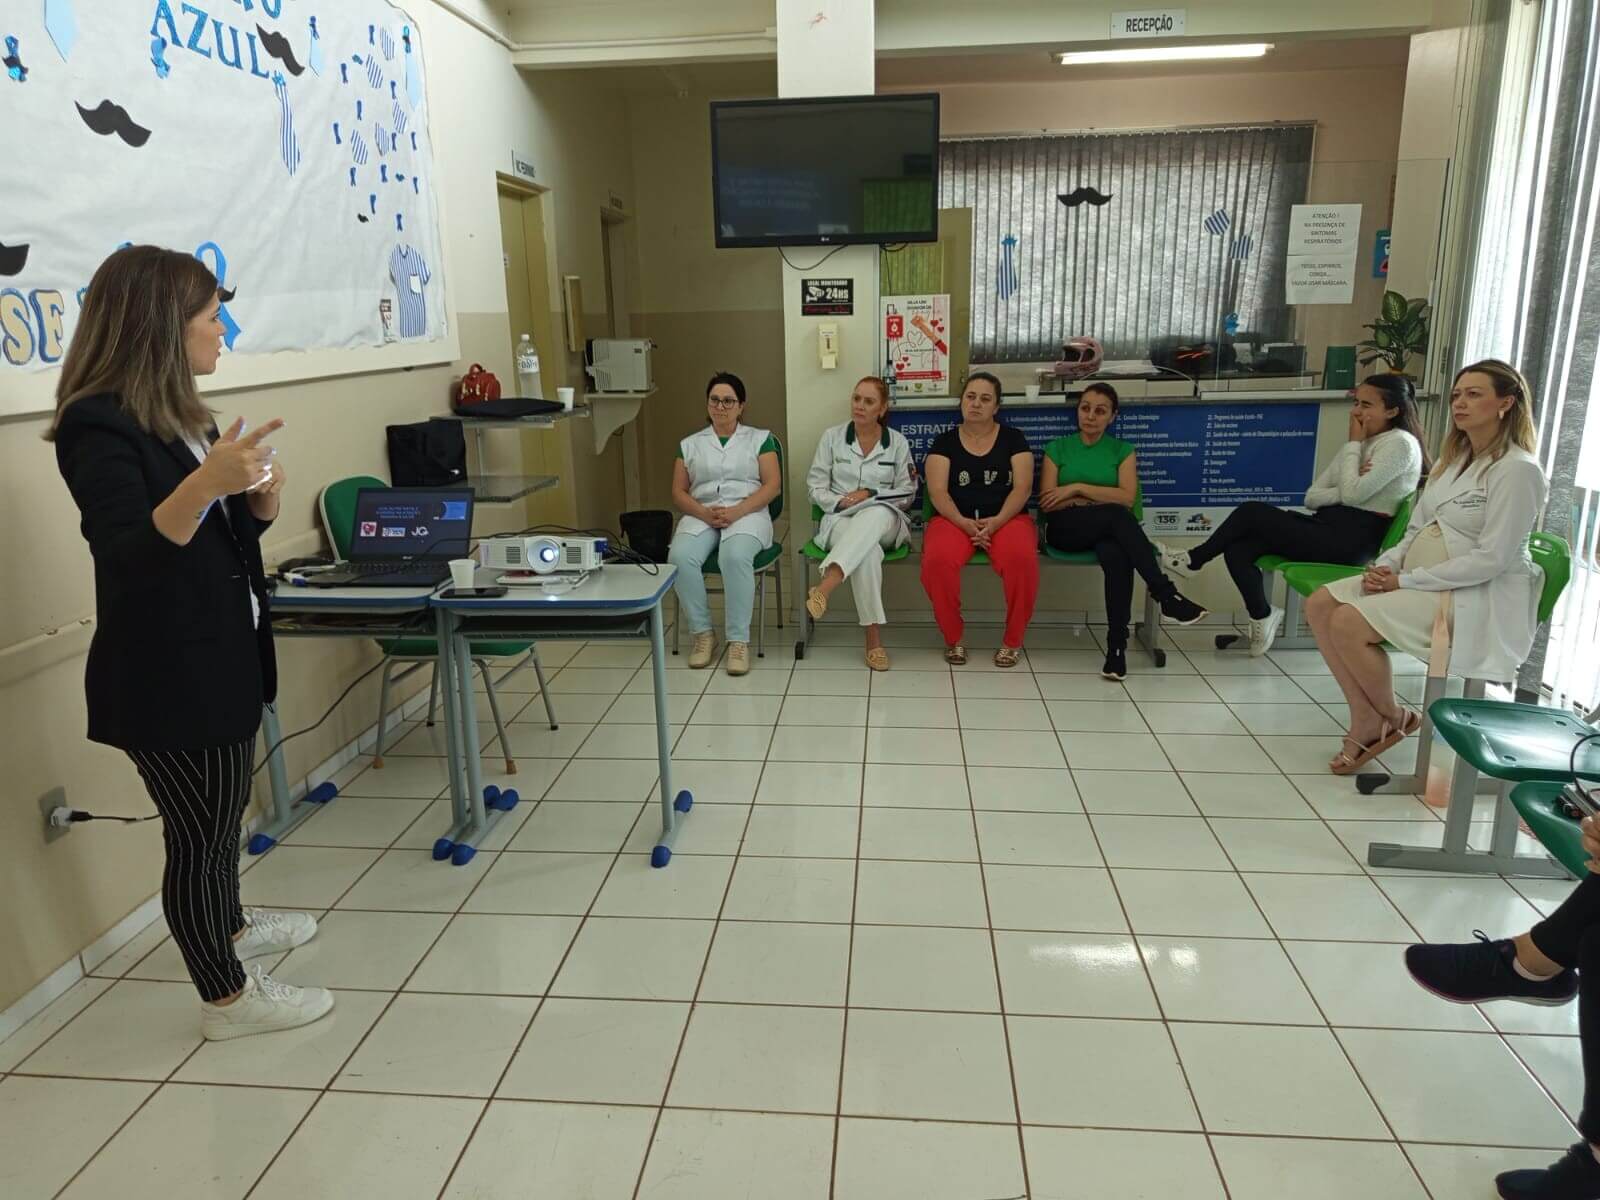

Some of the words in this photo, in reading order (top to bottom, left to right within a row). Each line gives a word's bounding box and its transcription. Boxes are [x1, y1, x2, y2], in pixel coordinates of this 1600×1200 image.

[1126, 14, 1173, 34] RECEPÇÃO
[150, 0, 269, 78] AZUL
[1312, 212, 1336, 220] ATENÇÃO
[826, 287, 849, 299] 24HS
